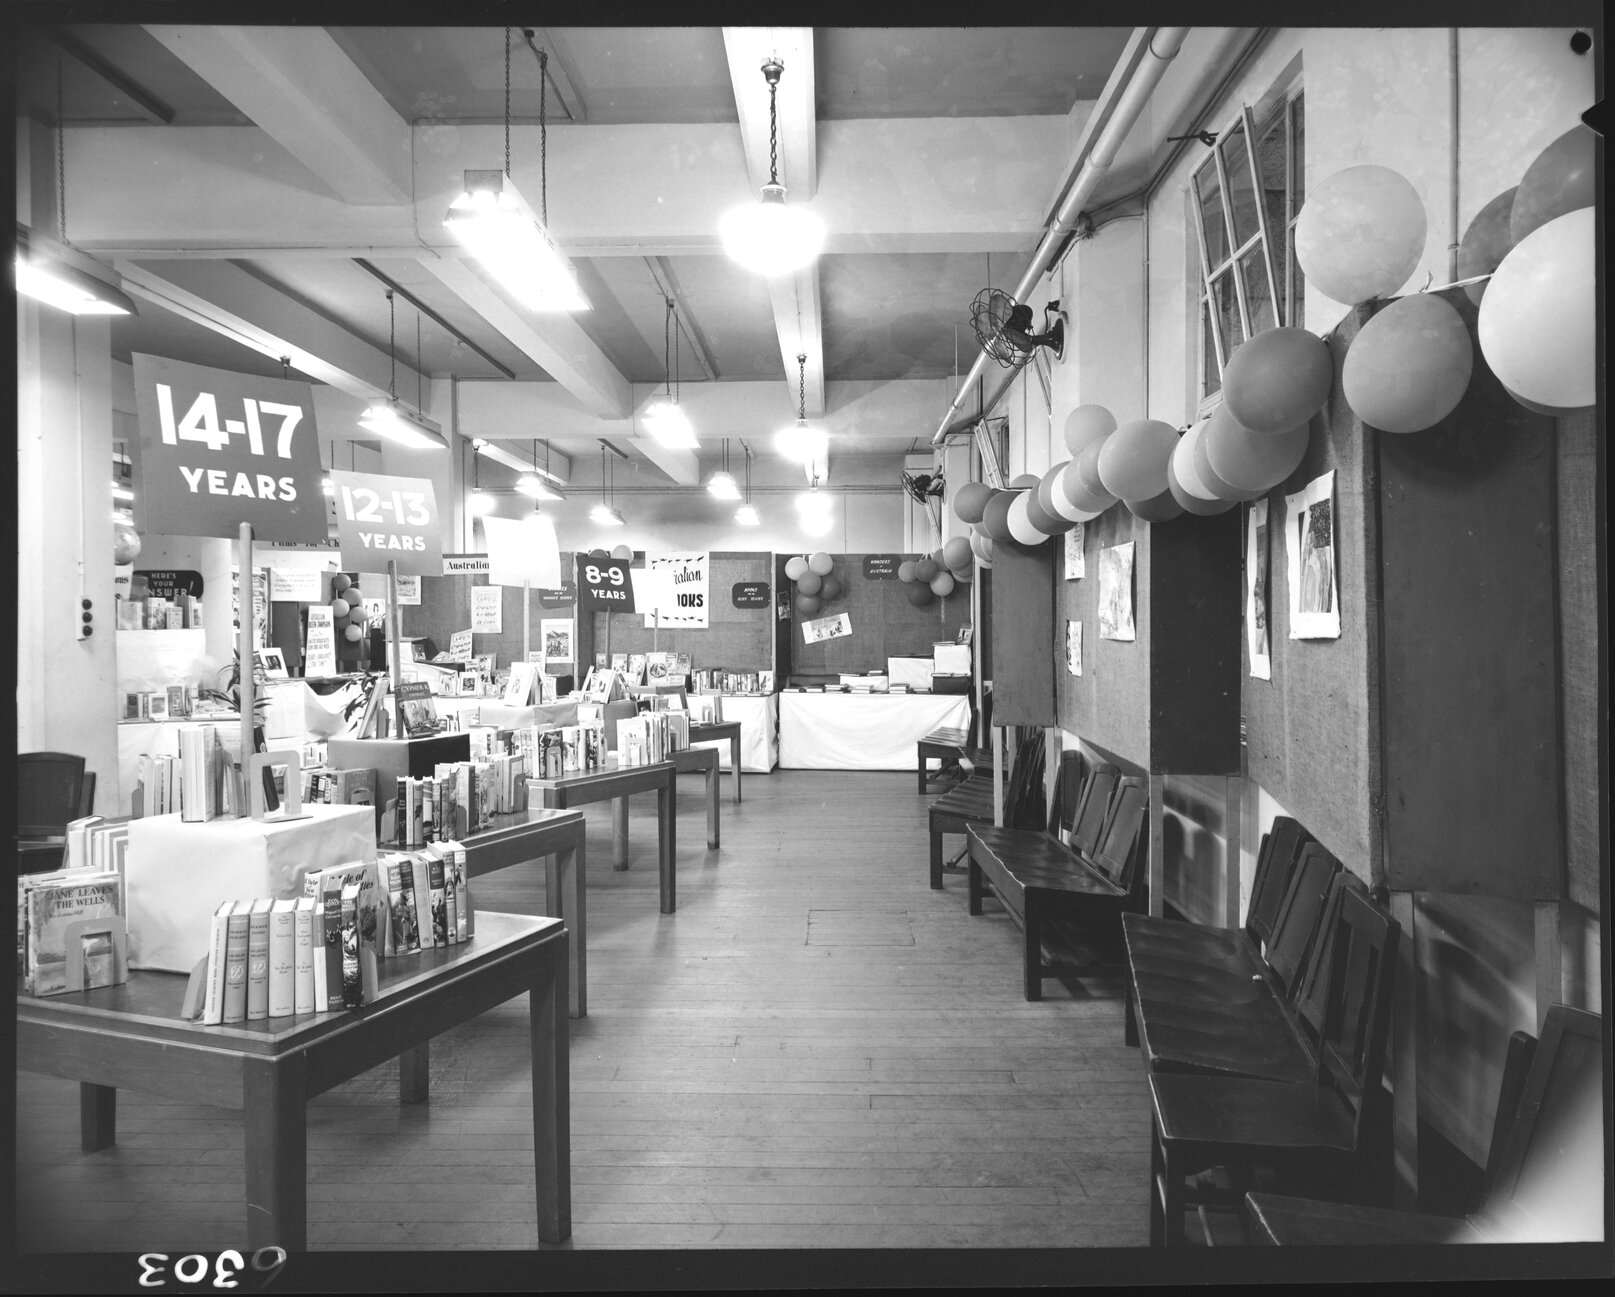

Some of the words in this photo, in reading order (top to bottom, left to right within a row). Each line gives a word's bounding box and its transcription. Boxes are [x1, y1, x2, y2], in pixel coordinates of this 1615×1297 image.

[156, 383, 303, 460] 14-17
[178, 465, 297, 502] YEARS
[341, 485, 430, 527] 12-13
[358, 532, 426, 551] YEARS
[585, 566, 625, 586] 8-9
[591, 588, 626, 601] YEARS
[355, 868, 367, 881] of
[50, 889, 74, 900] JANE
[78, 885, 114, 897] LEAVES
[55, 900, 75, 910] THE
[75, 896, 106, 907] WELLS
